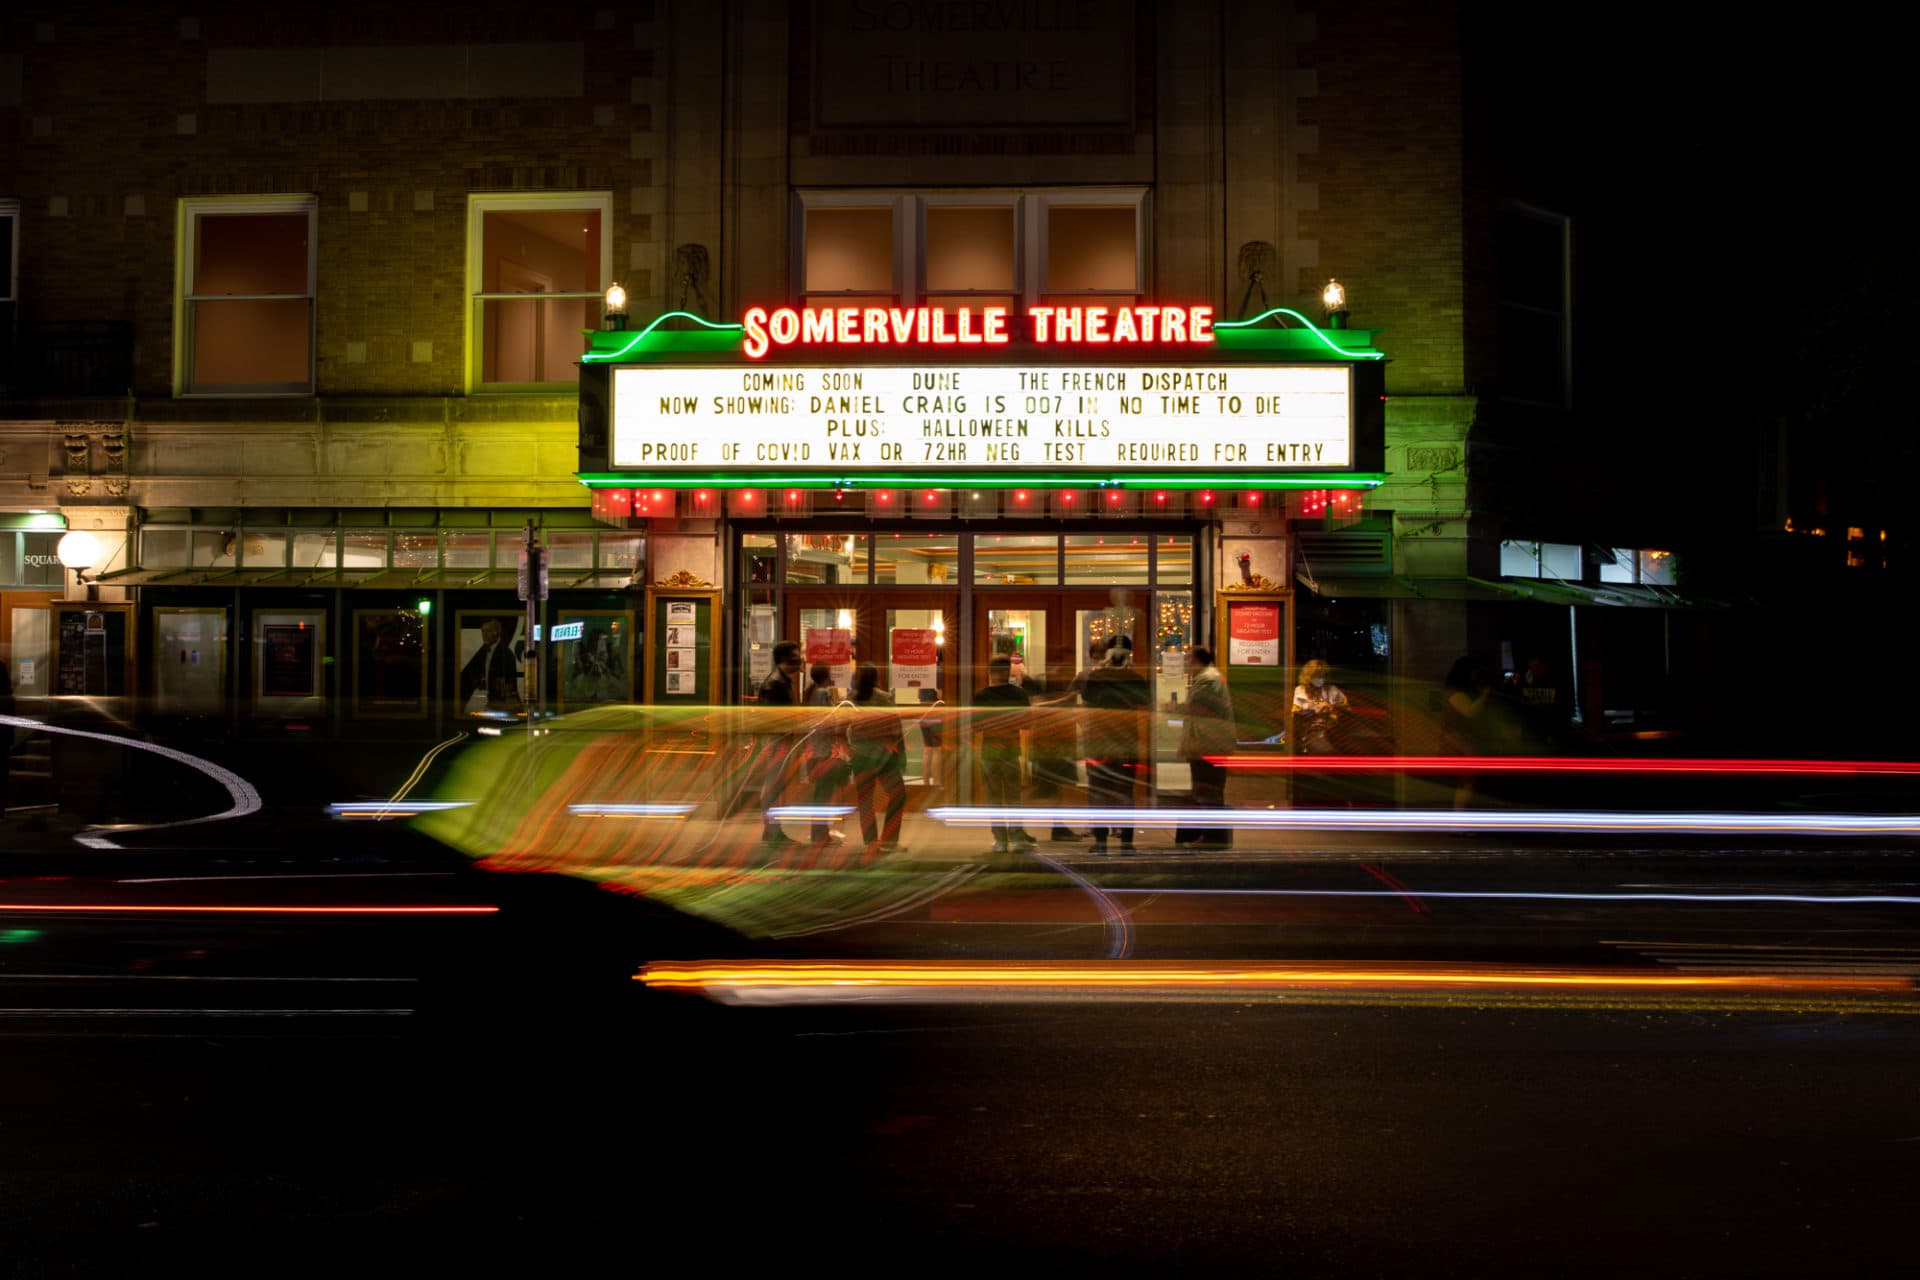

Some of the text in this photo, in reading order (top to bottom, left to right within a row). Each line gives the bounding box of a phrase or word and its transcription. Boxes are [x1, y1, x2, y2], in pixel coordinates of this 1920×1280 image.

[851, 1, 1097, 32] SOMERVILLE
[878, 54, 1072, 92] THEATRE
[743, 306, 1215, 358] SOMERVILLE THEATRE
[743, 372, 1227, 391] COMING SOON DUNE THE FRENCH DISPATCH
[660, 396, 1281, 415] NOW SHOWING: DANIEL CRAIG IS 007 IN NO TIME TO DIE
[827, 419, 1109, 437] PLUS: HALLOWEEN KILLS
[642, 443, 1323, 461] PROOF OF COVID VAX OR 72HR NEG TEST REQUIRED FOR ENTRY
[24, 554, 60, 567] SQUAR
